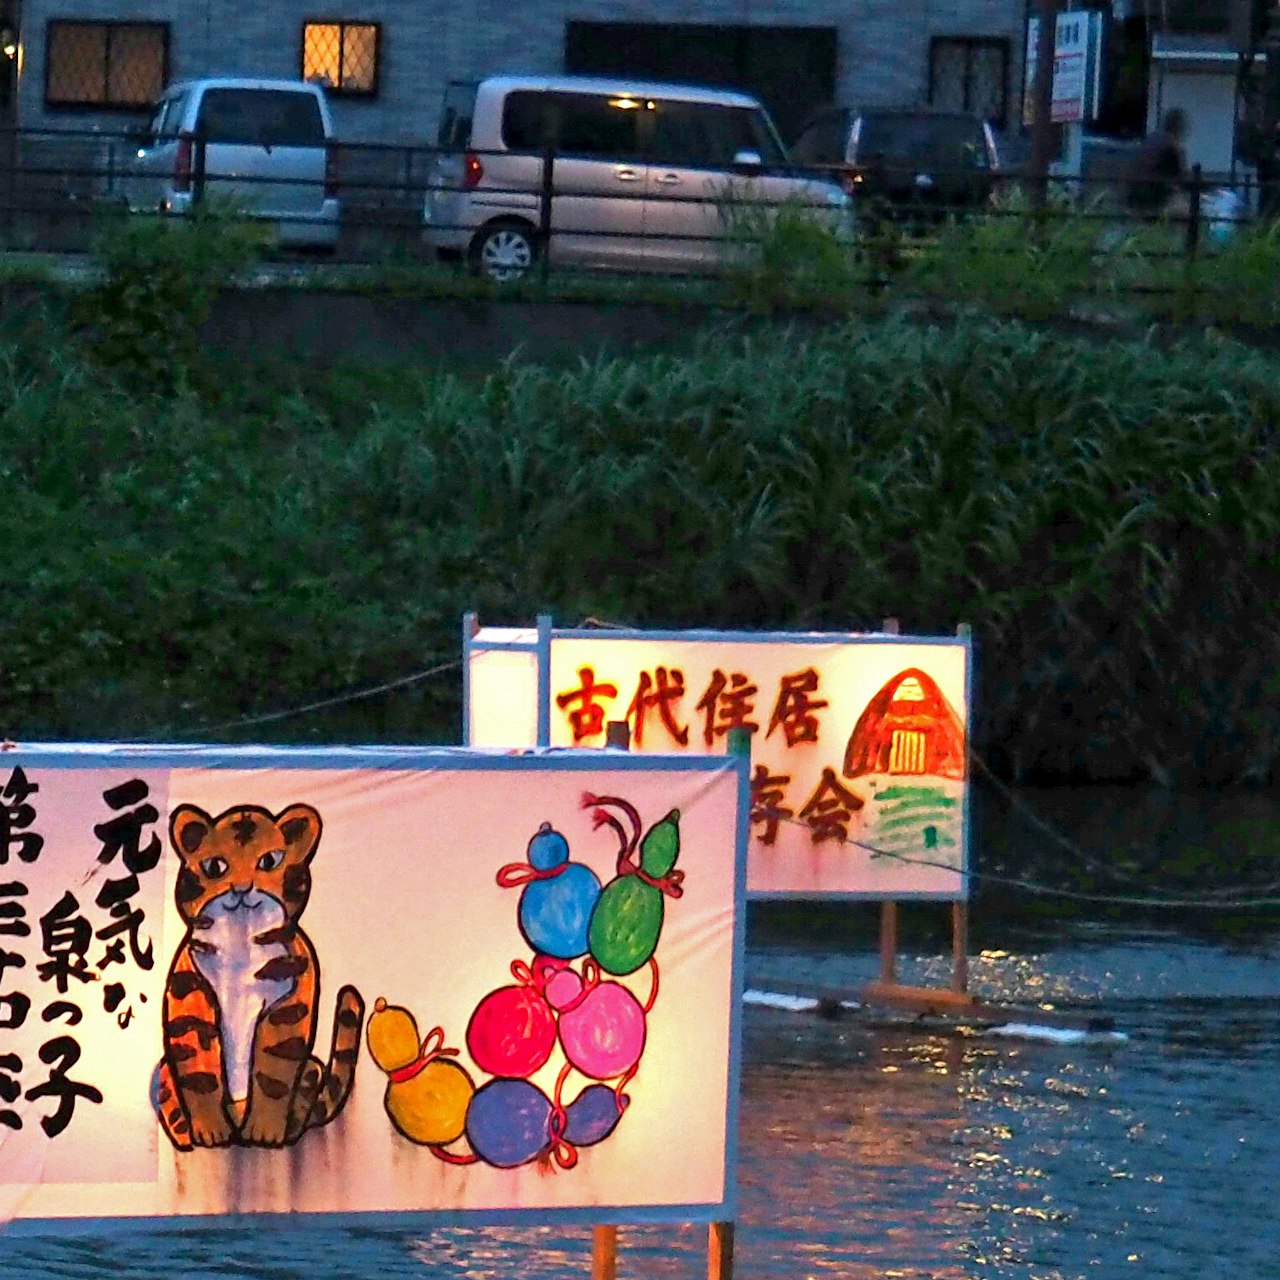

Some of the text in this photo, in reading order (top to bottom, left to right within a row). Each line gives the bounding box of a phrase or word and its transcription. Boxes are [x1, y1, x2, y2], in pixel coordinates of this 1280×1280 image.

[556, 665, 829, 748] 古代住居
[25, 890, 103, 1138] 泉っ子
[93, 778, 162, 1030] 元気な
